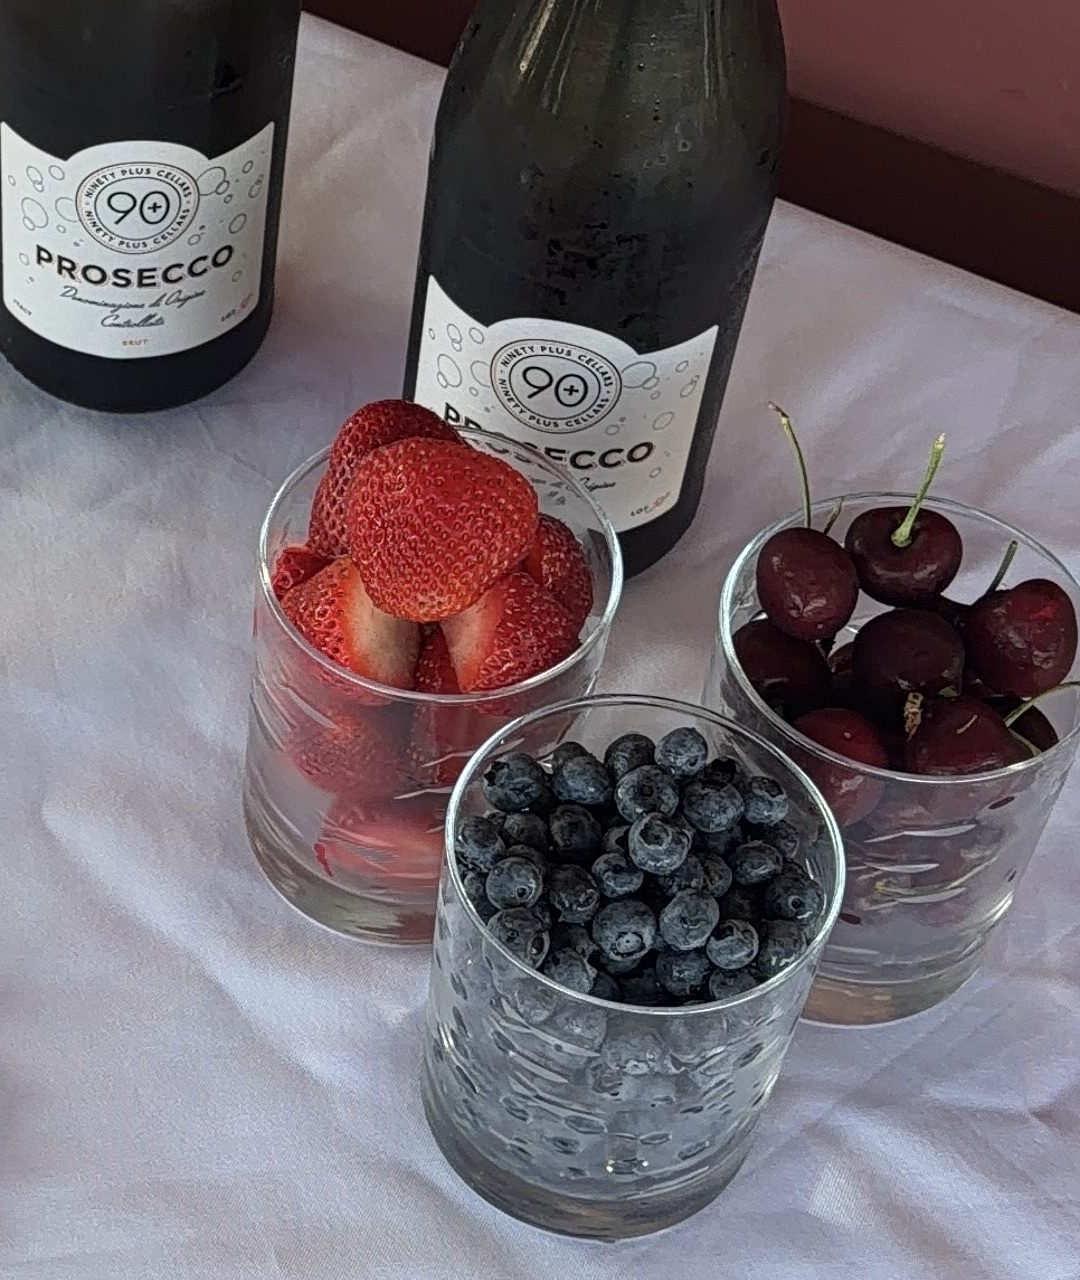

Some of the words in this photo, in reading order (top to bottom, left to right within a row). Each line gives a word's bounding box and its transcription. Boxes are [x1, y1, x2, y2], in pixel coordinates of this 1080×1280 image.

[84, 171, 116, 199] NINETY
[120, 167, 152, 176] PLUS
[156, 169, 192, 198] CELLARS
[84, 210, 116, 243] NINETY
[118, 240, 148, 249] PLUS
[152, 208, 191, 245] CELLARS
[35, 243, 234, 289] PROSECCO
[500, 345, 535, 368] NINETY
[540, 345, 572, 357] PLUS
[577, 354, 614, 387] CELLARS
[498, 378, 526, 415] NINETY
[528, 415, 559, 428] PLUS
[564, 397, 610, 428] CELLARS
[443, 402, 655, 470] PECCO
